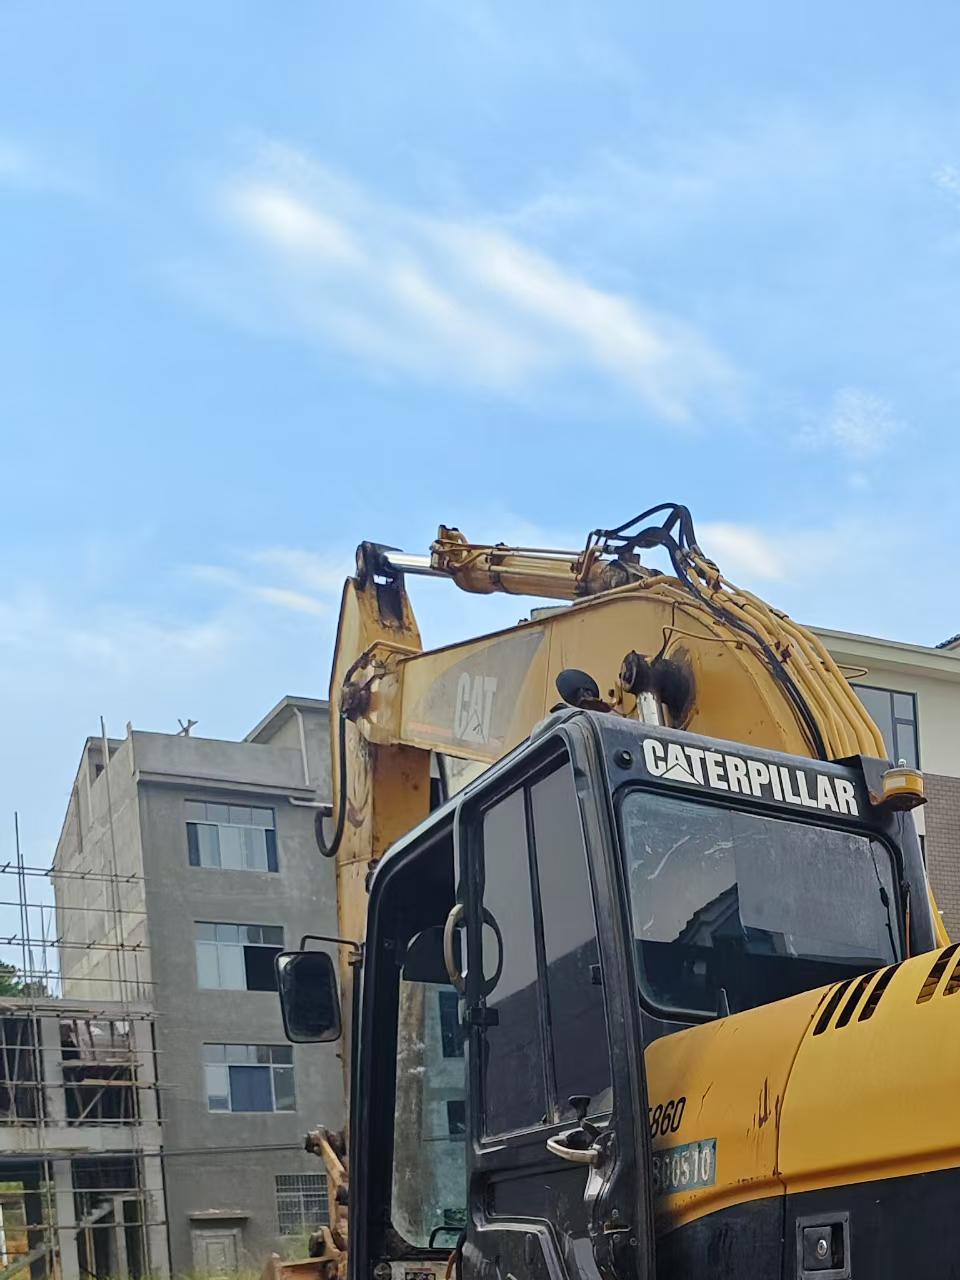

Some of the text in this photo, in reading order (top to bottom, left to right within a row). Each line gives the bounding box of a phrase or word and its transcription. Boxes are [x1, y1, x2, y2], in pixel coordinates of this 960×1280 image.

[454, 671, 498, 745] CAT
[642, 738, 859, 817] CATERPILLAR
[648, 1096, 687, 1139] 860
